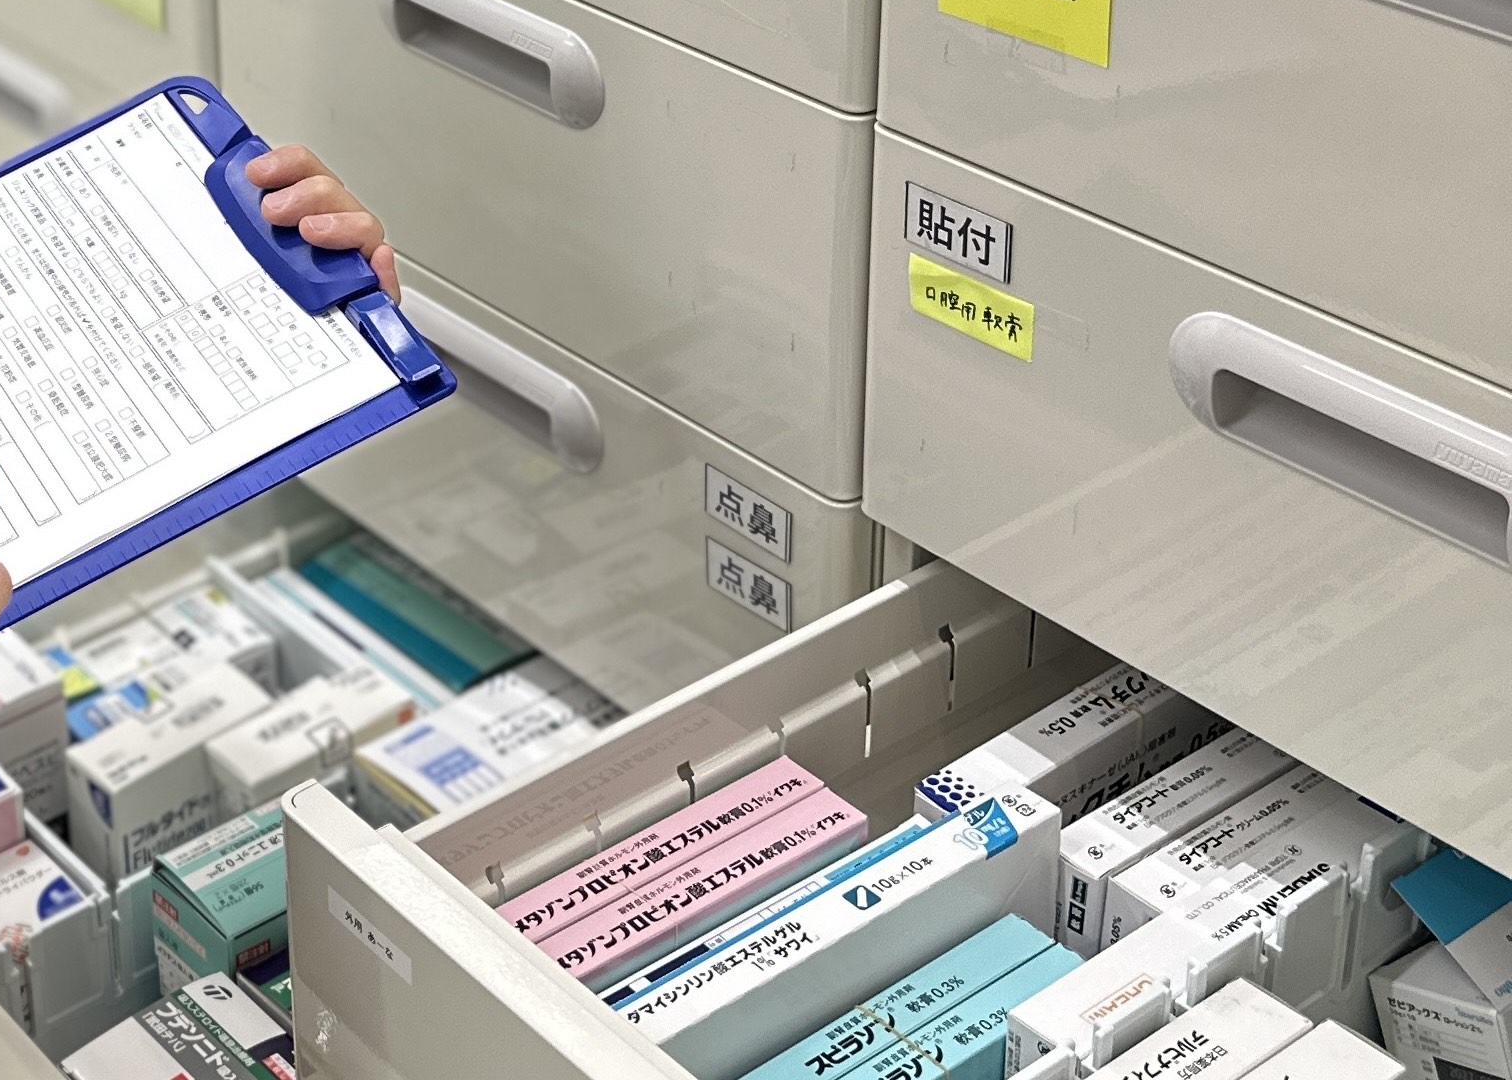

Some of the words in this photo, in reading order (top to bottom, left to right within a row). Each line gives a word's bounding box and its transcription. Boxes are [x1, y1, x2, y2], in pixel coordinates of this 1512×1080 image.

[917, 198, 996, 266] 貼付
[715, 484, 778, 544] 点鼻
[717, 556, 779, 615] 点鼻
[1112, 783, 1168, 823] ダイアコート
[1178, 824, 1234, 864] ダイアコート
[905, 975, 965, 1013] 軟膏0.3%
[156, 1001, 230, 1066] ブデソニド
[1122, 1030, 1210, 1080] テルビナフィ
